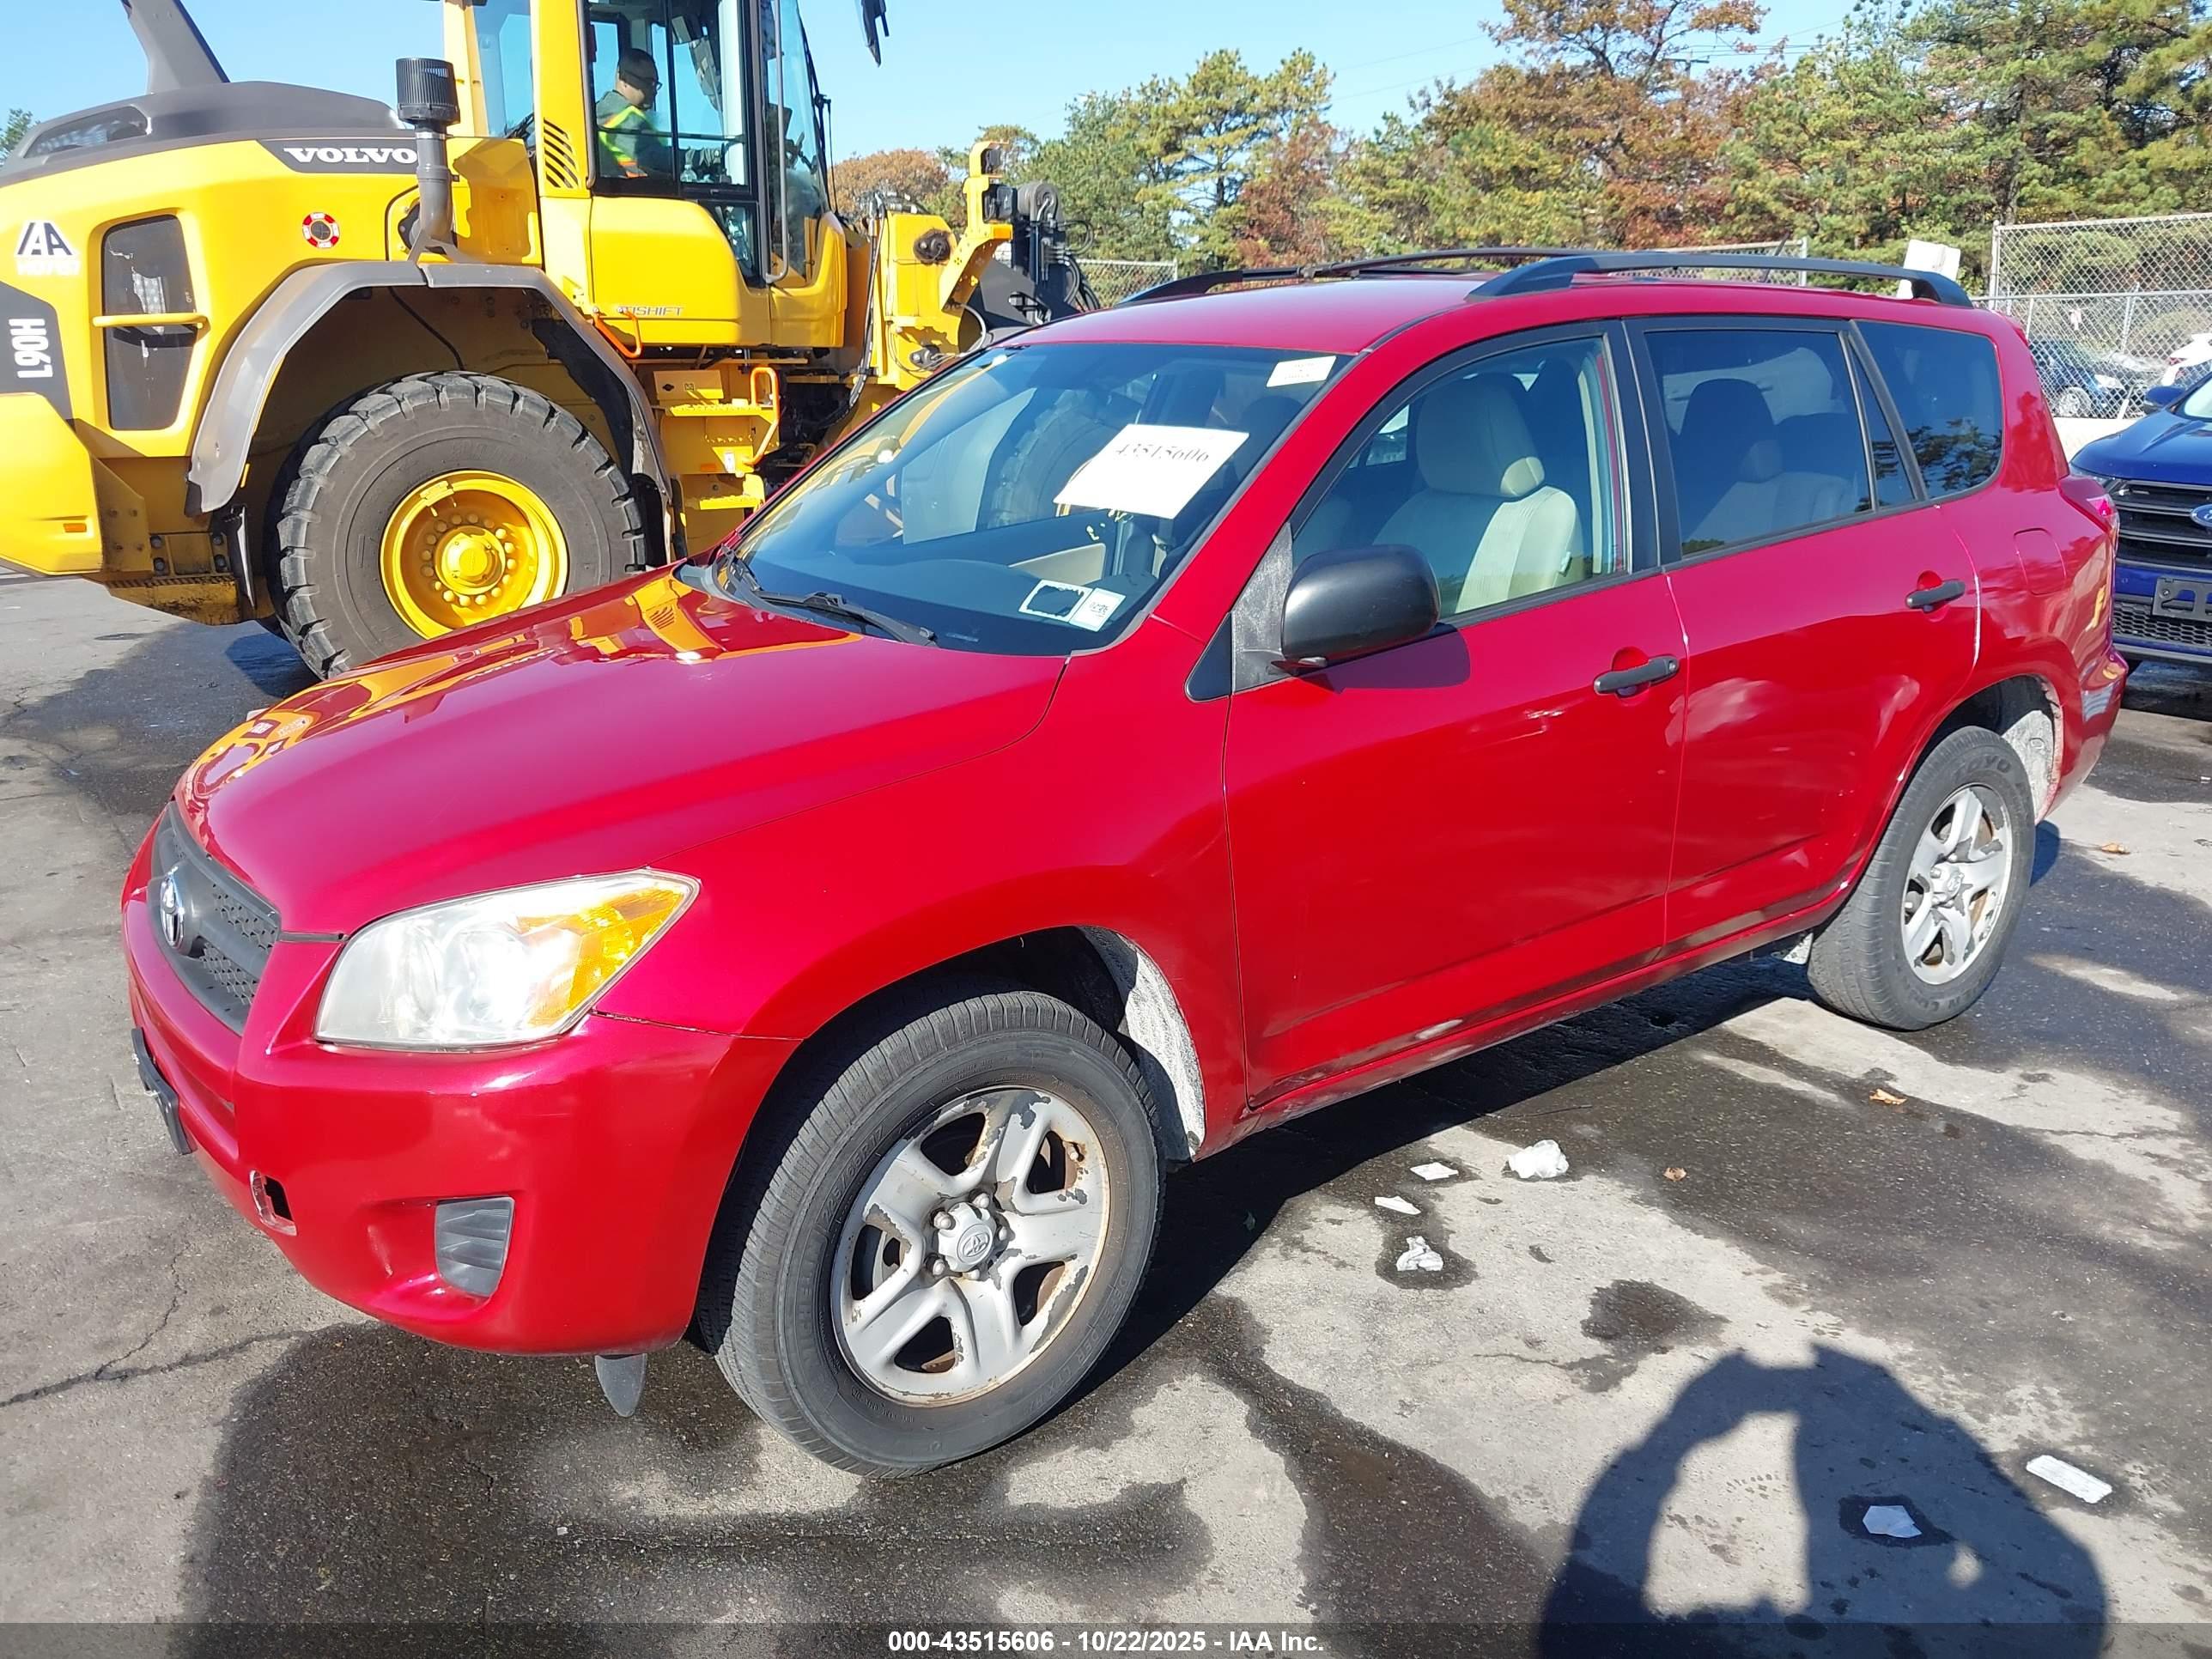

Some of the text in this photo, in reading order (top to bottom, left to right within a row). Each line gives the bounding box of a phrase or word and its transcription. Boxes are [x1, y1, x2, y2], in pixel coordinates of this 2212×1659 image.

[283, 147, 417, 164] VOLVO
[8, 318, 54, 379] L90H
[1115, 442, 1209, 463] 43515606
